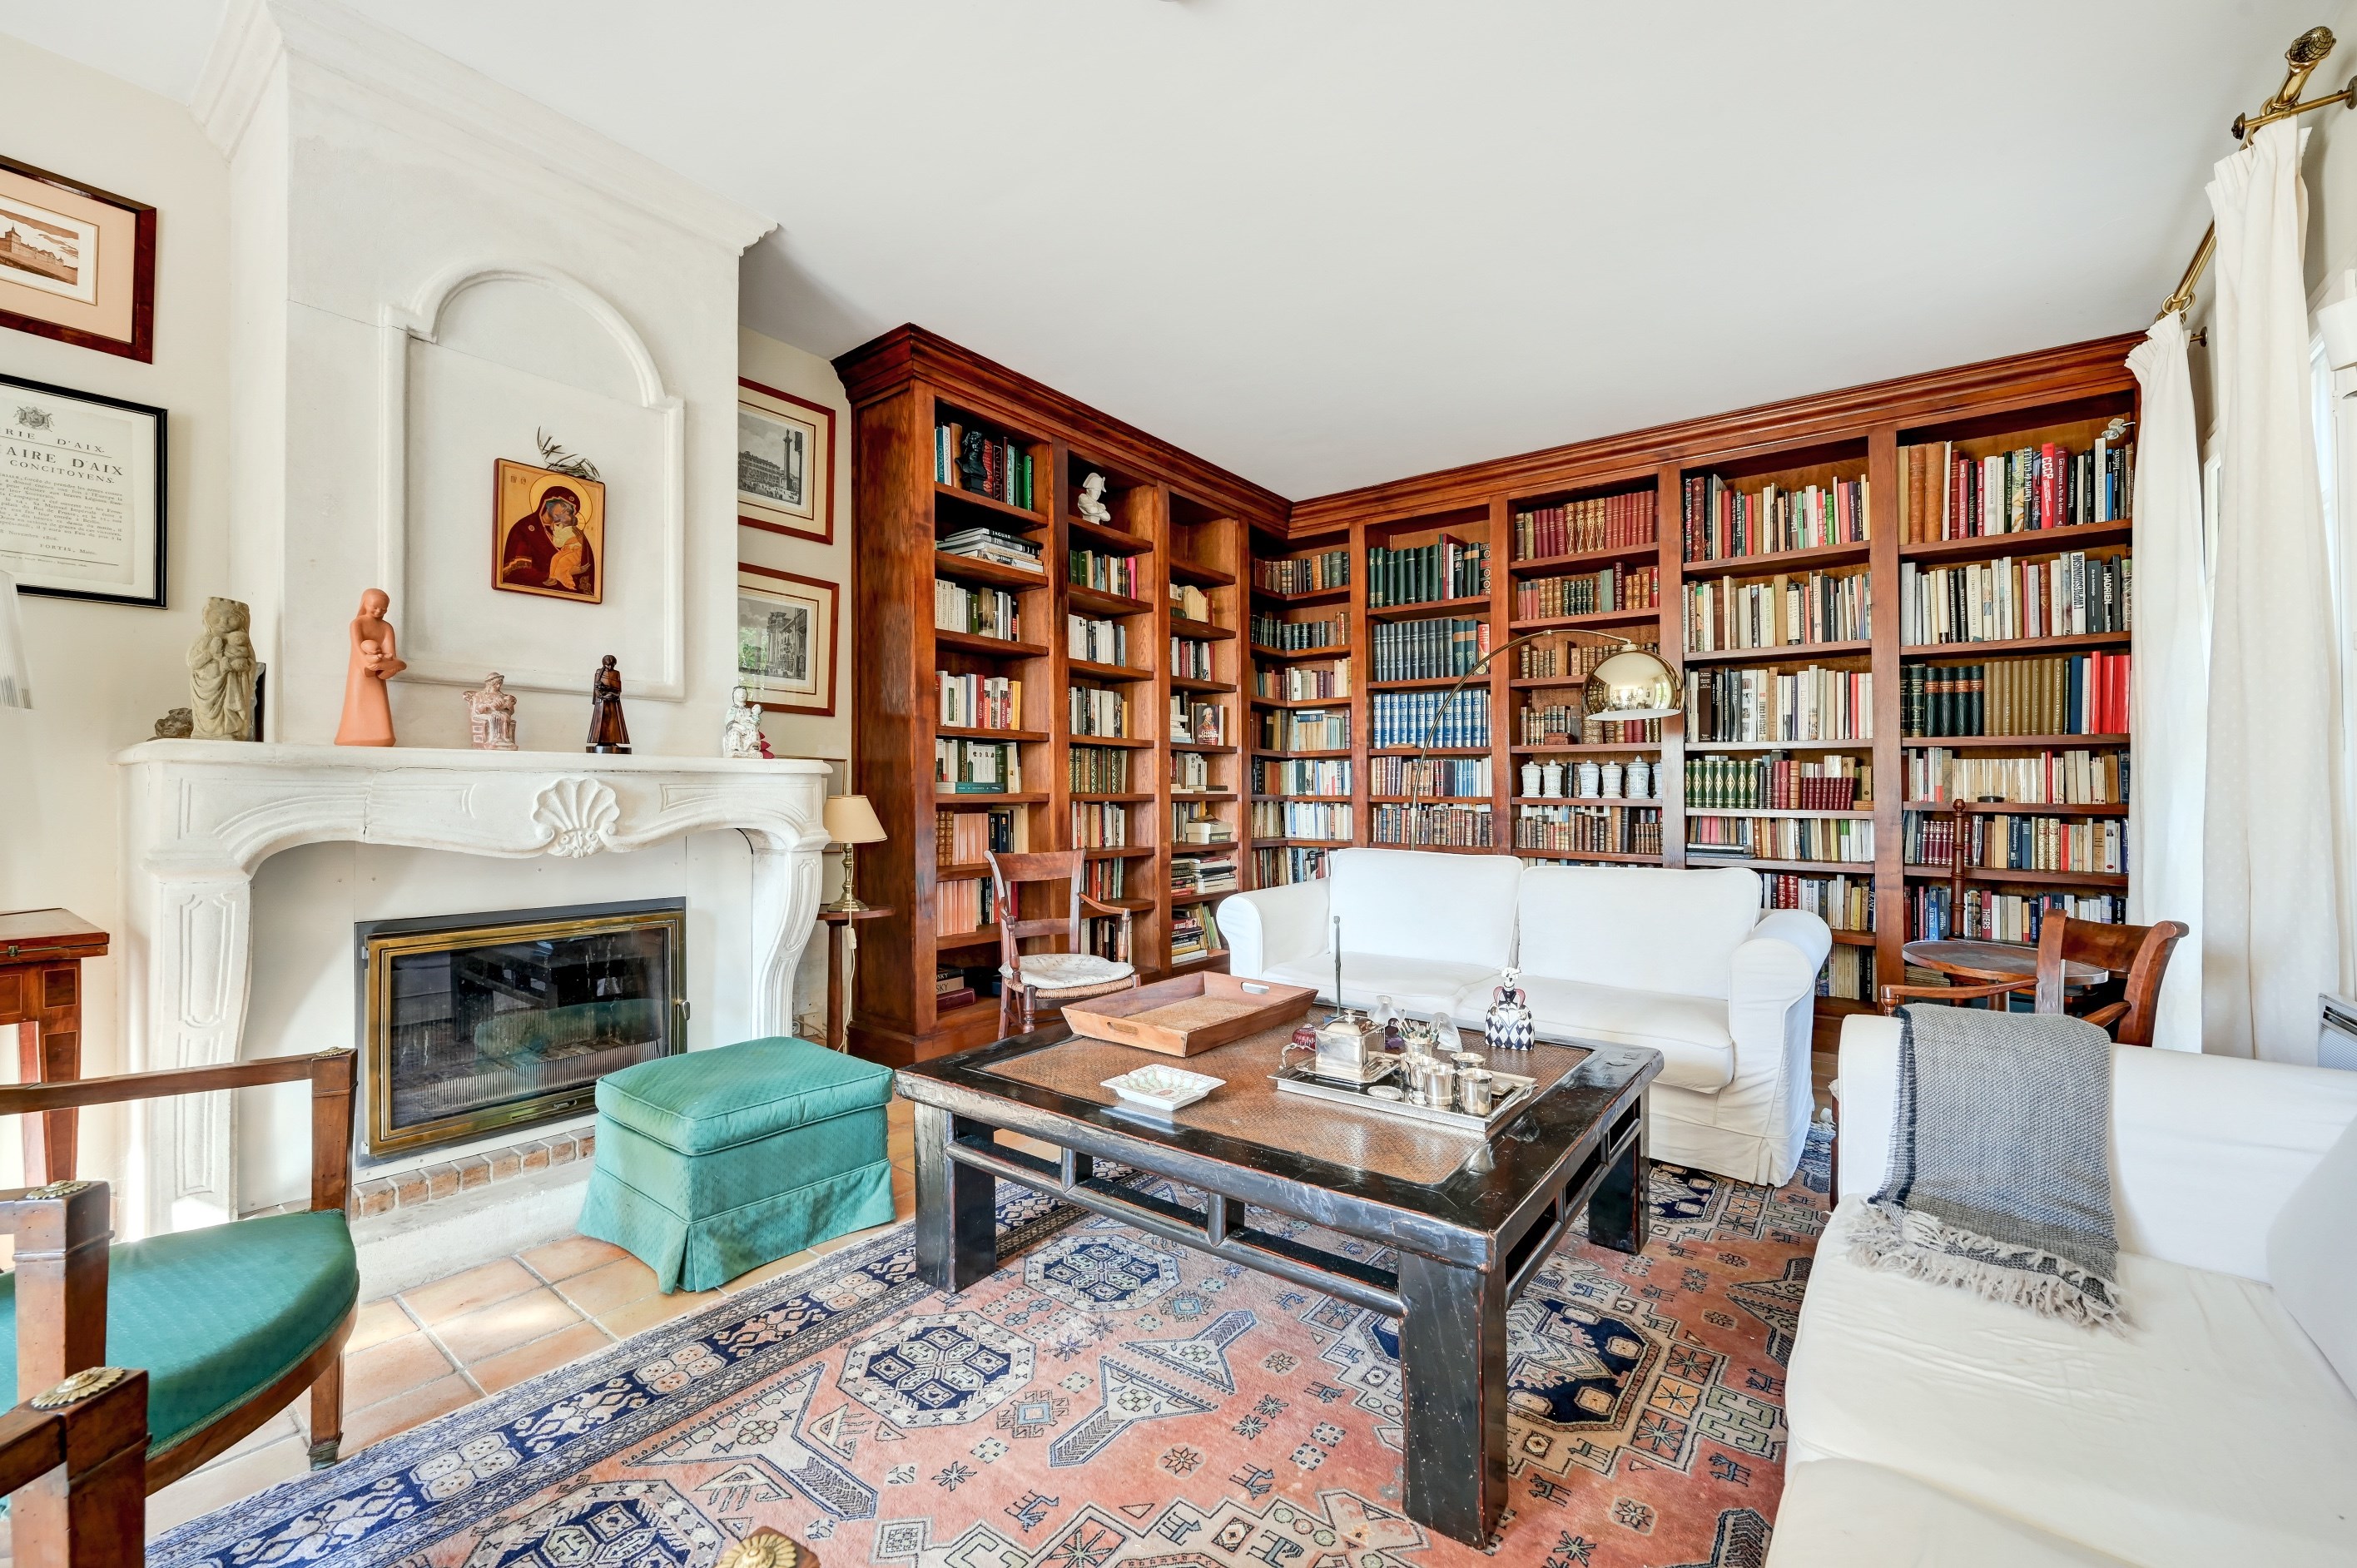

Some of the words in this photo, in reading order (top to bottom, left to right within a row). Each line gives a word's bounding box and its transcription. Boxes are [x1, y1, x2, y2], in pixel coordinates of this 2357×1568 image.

[0, 445, 56, 464] AIRE
[72, 458, 123, 476] D'AIX
[10, 459, 114, 484] CONCITOYENS.
[2042, 457, 2054, 479] CCCP
[992, 531, 1011, 539] JAGUAR
[2072, 554, 2084, 609] L'IMPRESSIONNISME
[2103, 573, 2112, 604] HADRIEN
[1982, 909, 1991, 930] THIERS
